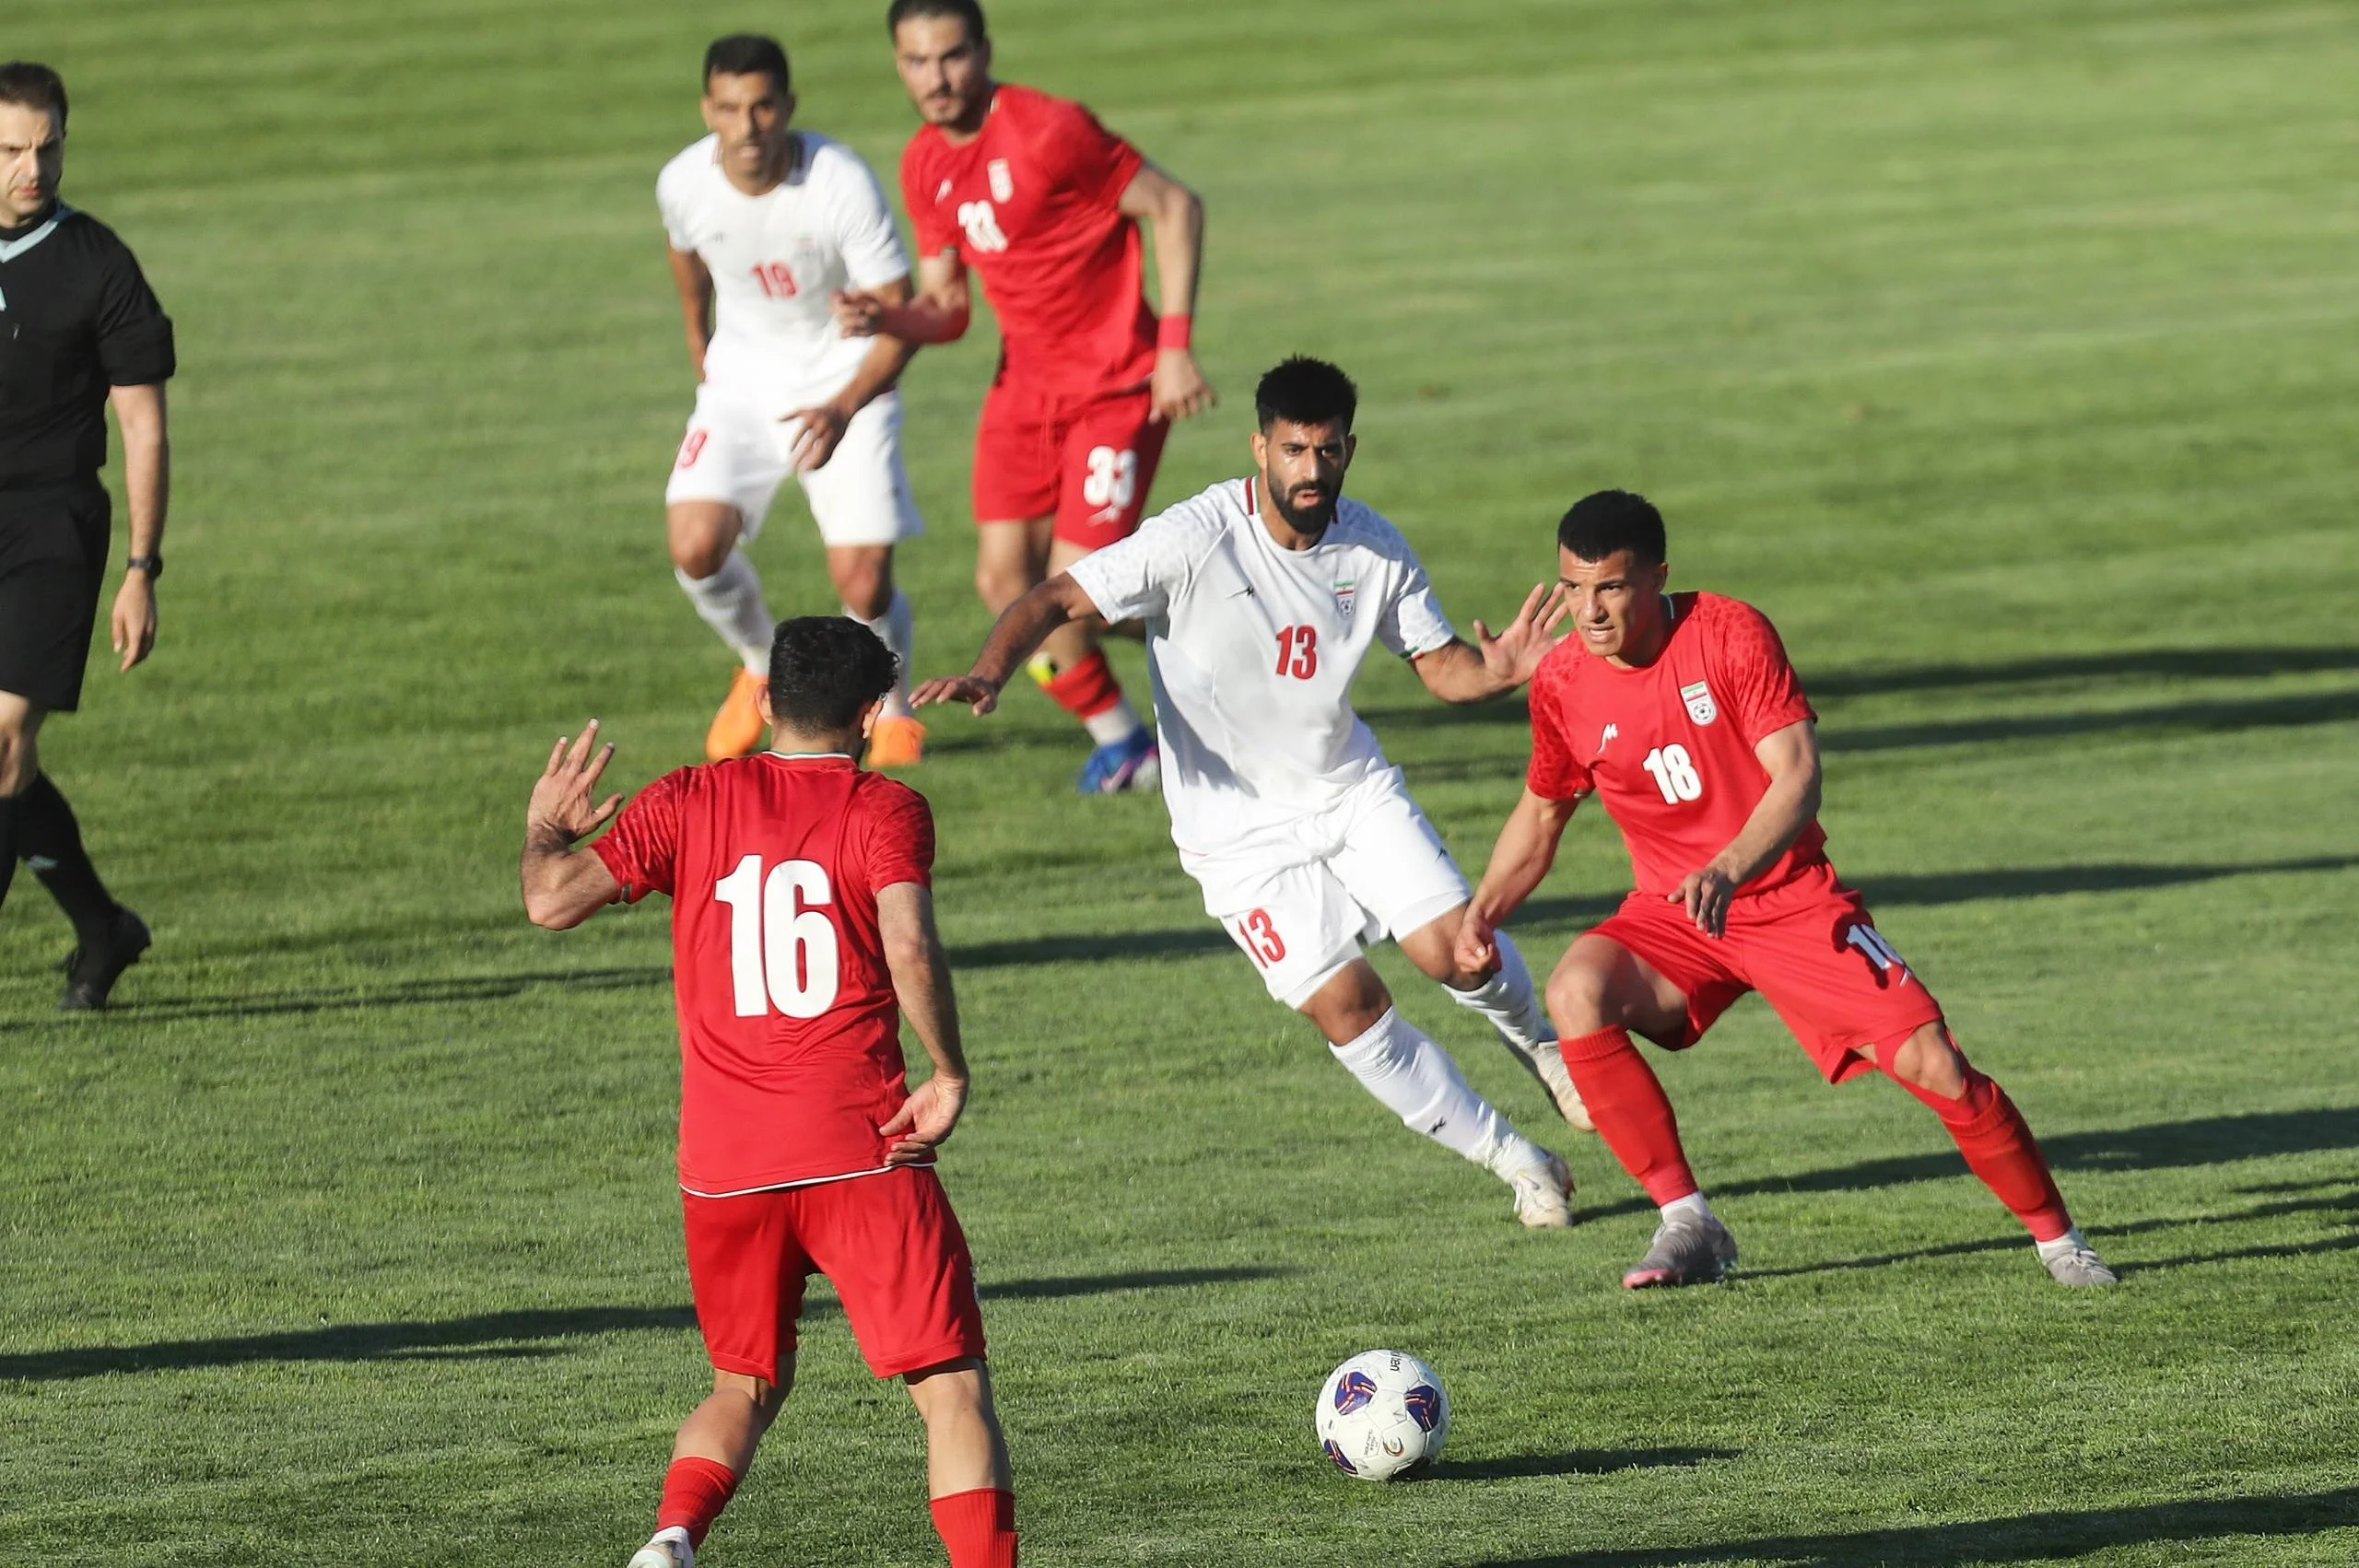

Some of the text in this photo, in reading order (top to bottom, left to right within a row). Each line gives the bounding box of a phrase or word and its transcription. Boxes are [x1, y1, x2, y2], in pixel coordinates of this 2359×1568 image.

[680, 428, 709, 470] 9
[1084, 445, 1137, 508] 33
[1275, 625, 1317, 680] 13
[1642, 743, 1703, 805] 18
[714, 854, 839, 1019] 16
[1238, 908, 1285, 969] 13
